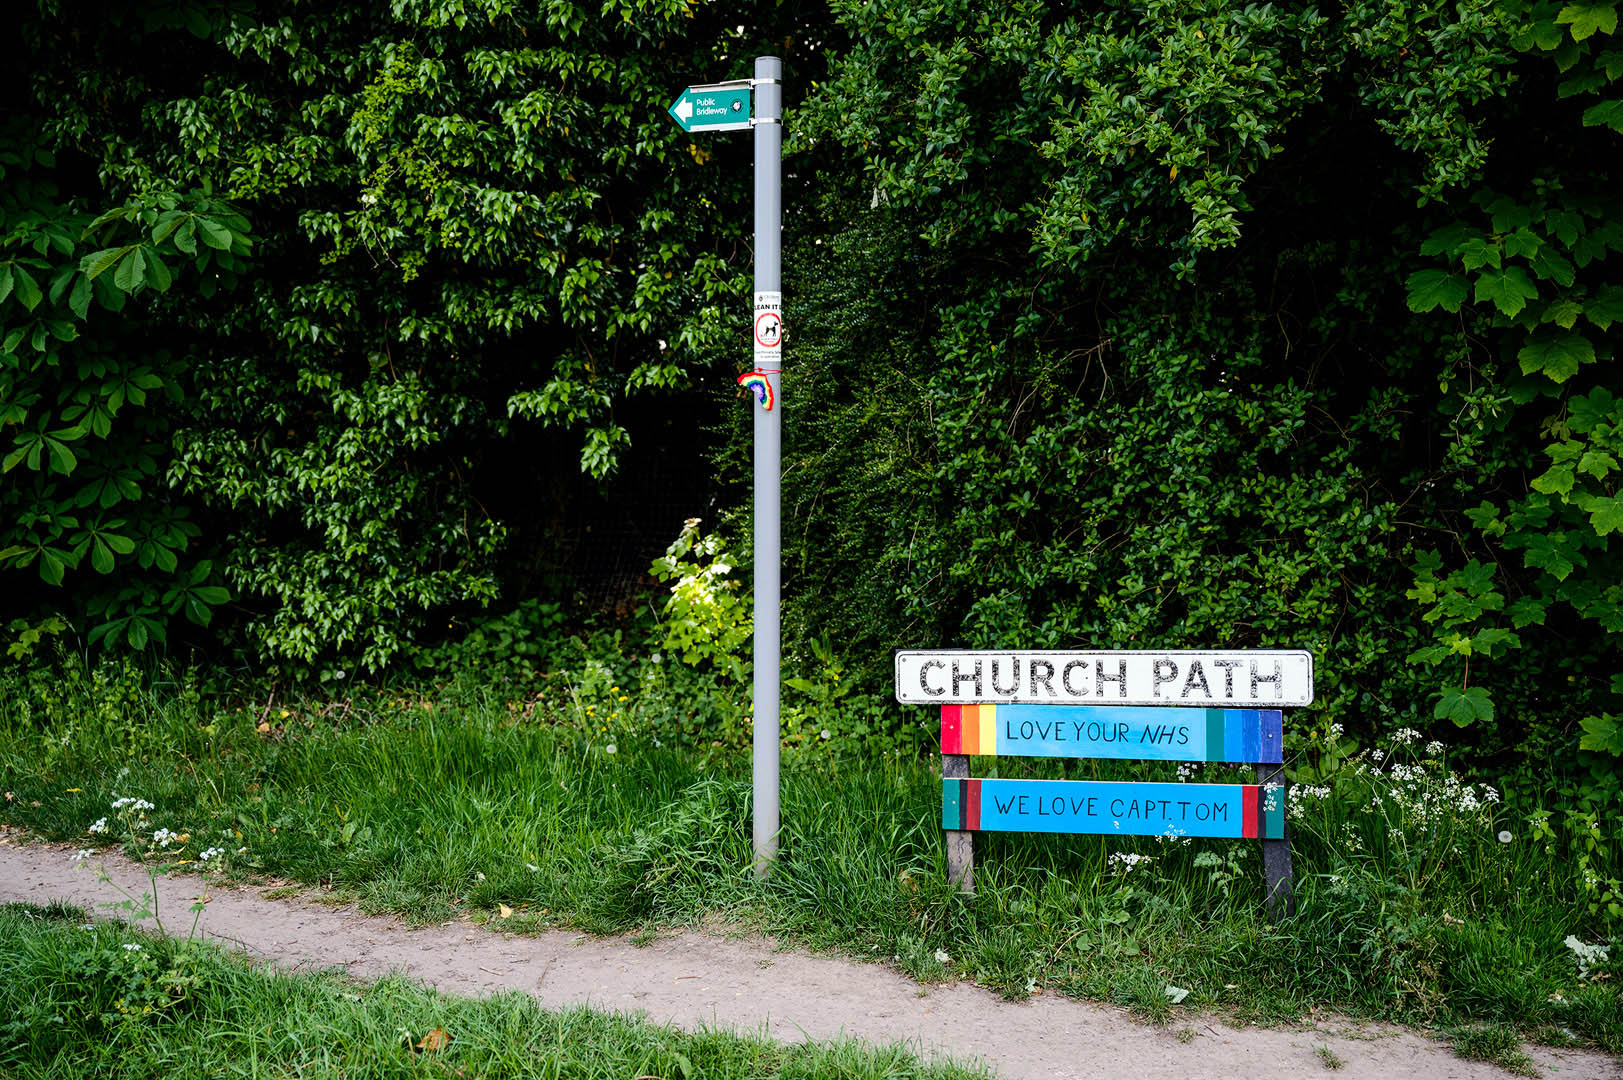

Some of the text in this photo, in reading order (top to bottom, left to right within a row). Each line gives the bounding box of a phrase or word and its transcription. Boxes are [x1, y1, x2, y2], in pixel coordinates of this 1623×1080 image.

[696, 97, 715, 106] Public
[696, 107, 727, 116] Bridleway
[919, 659, 1283, 699] CHURCH PATH
[1006, 720, 1190, 745] LOVE YOUR NHS
[994, 795, 1030, 815] WE
[1039, 796, 1098, 816] LOVE
